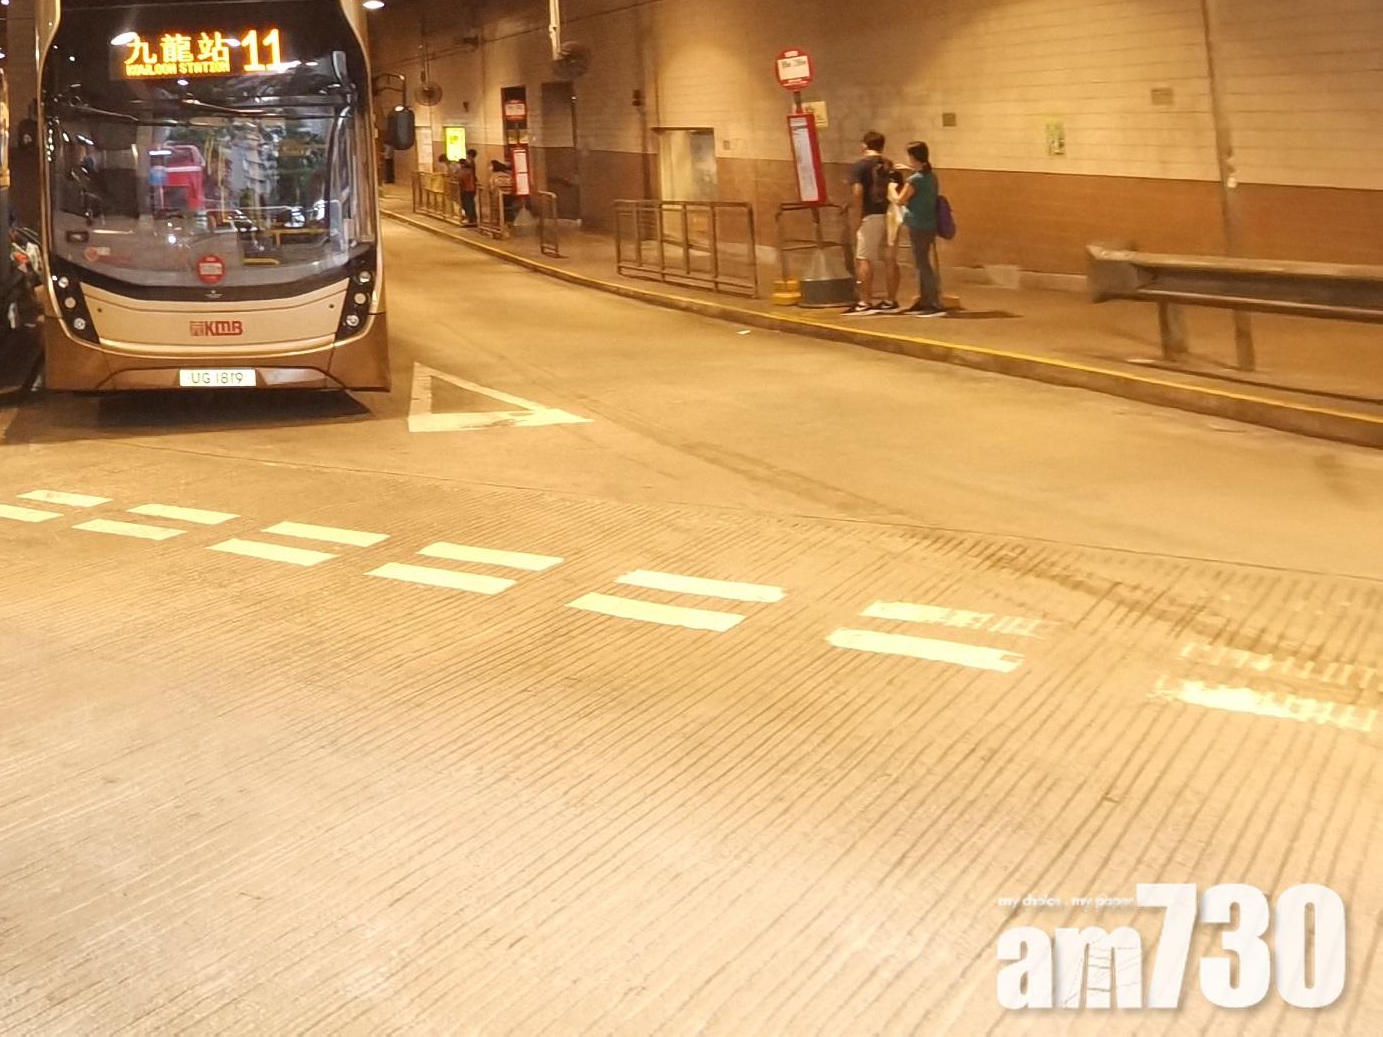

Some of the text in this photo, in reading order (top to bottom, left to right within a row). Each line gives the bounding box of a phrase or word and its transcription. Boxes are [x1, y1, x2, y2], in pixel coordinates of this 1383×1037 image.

[124, 31, 230, 64] 九龍站
[241, 28, 282, 72] 11
[179, 61, 230, 74] STATION
[205, 320, 243, 337] KMB
[191, 372, 244, 384] UG 1819
